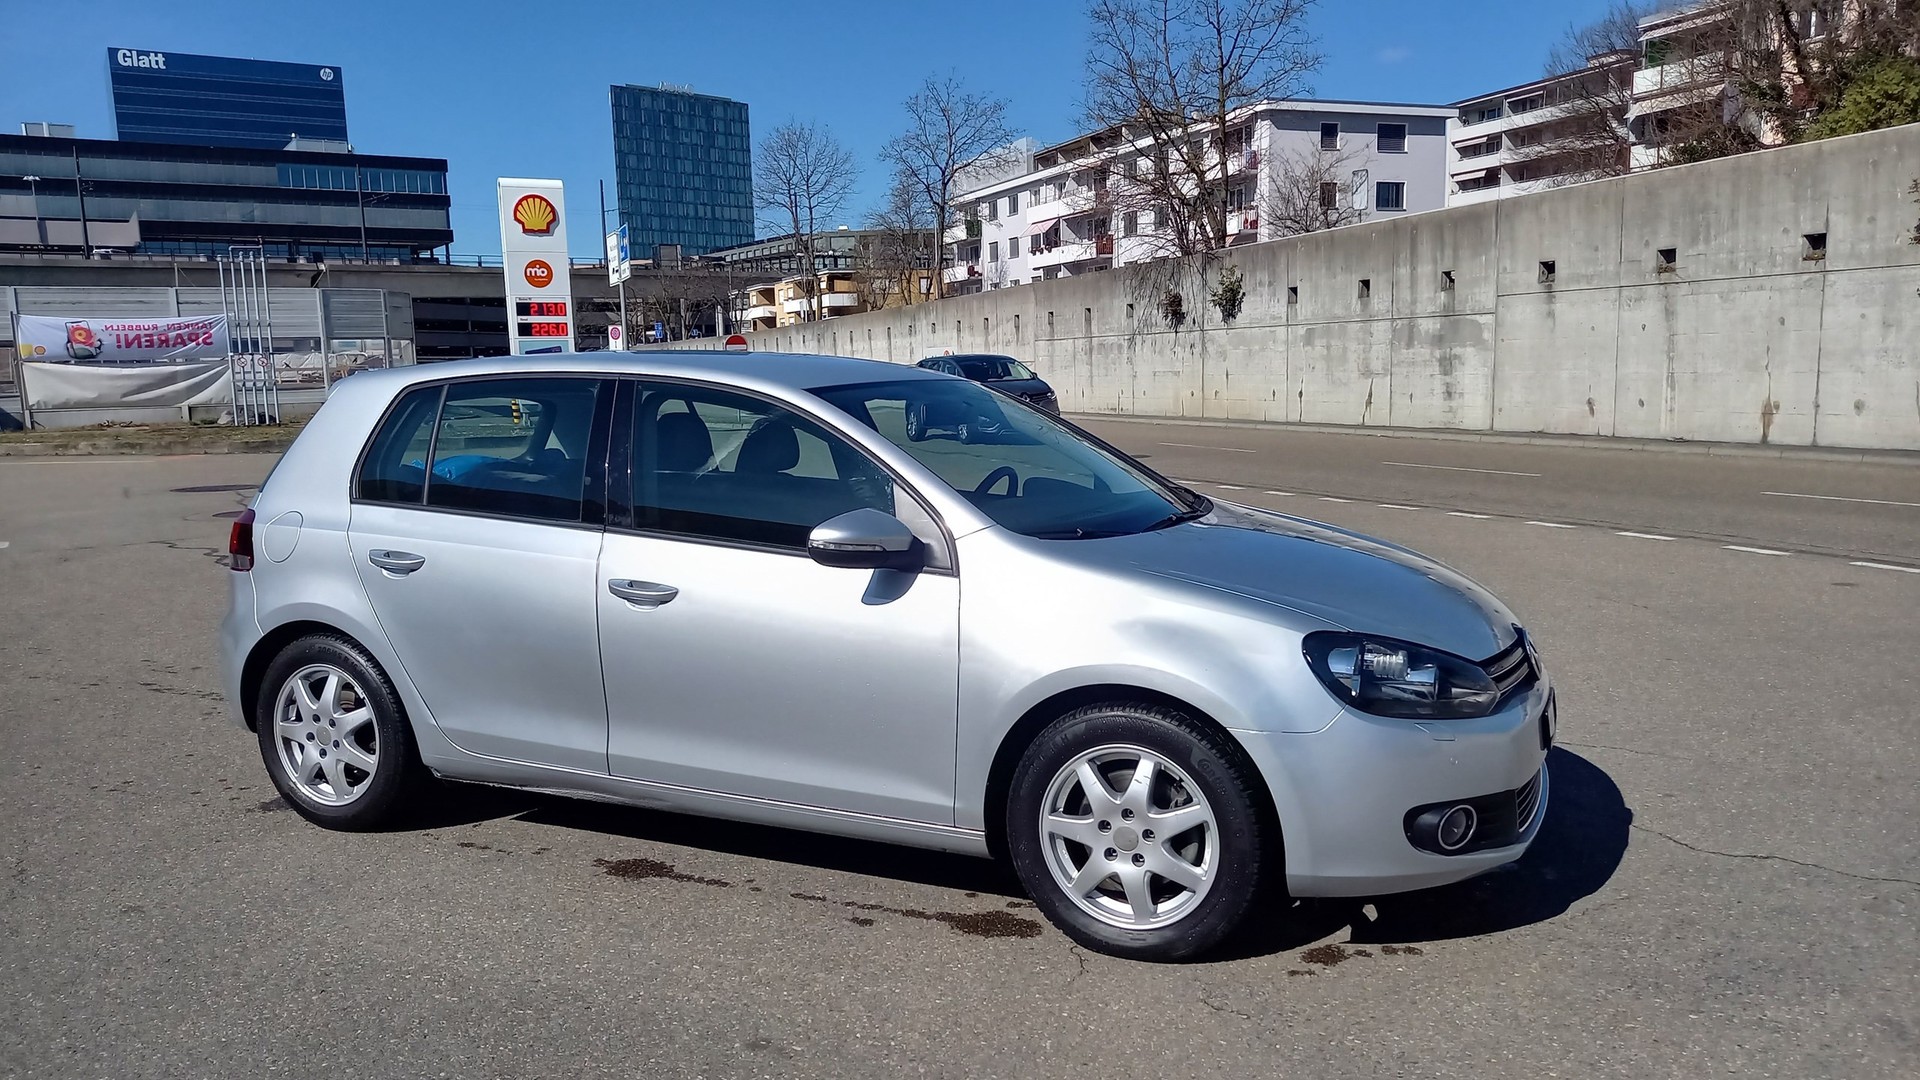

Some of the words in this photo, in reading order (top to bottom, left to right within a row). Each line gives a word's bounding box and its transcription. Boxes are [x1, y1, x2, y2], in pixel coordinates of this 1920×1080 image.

[117, 49, 166, 69] Glatt
[321, 67, 333, 80] hp
[526, 264, 548, 277] mio
[530, 303, 566, 316] 213.0
[531, 323, 567, 336] 226.0
